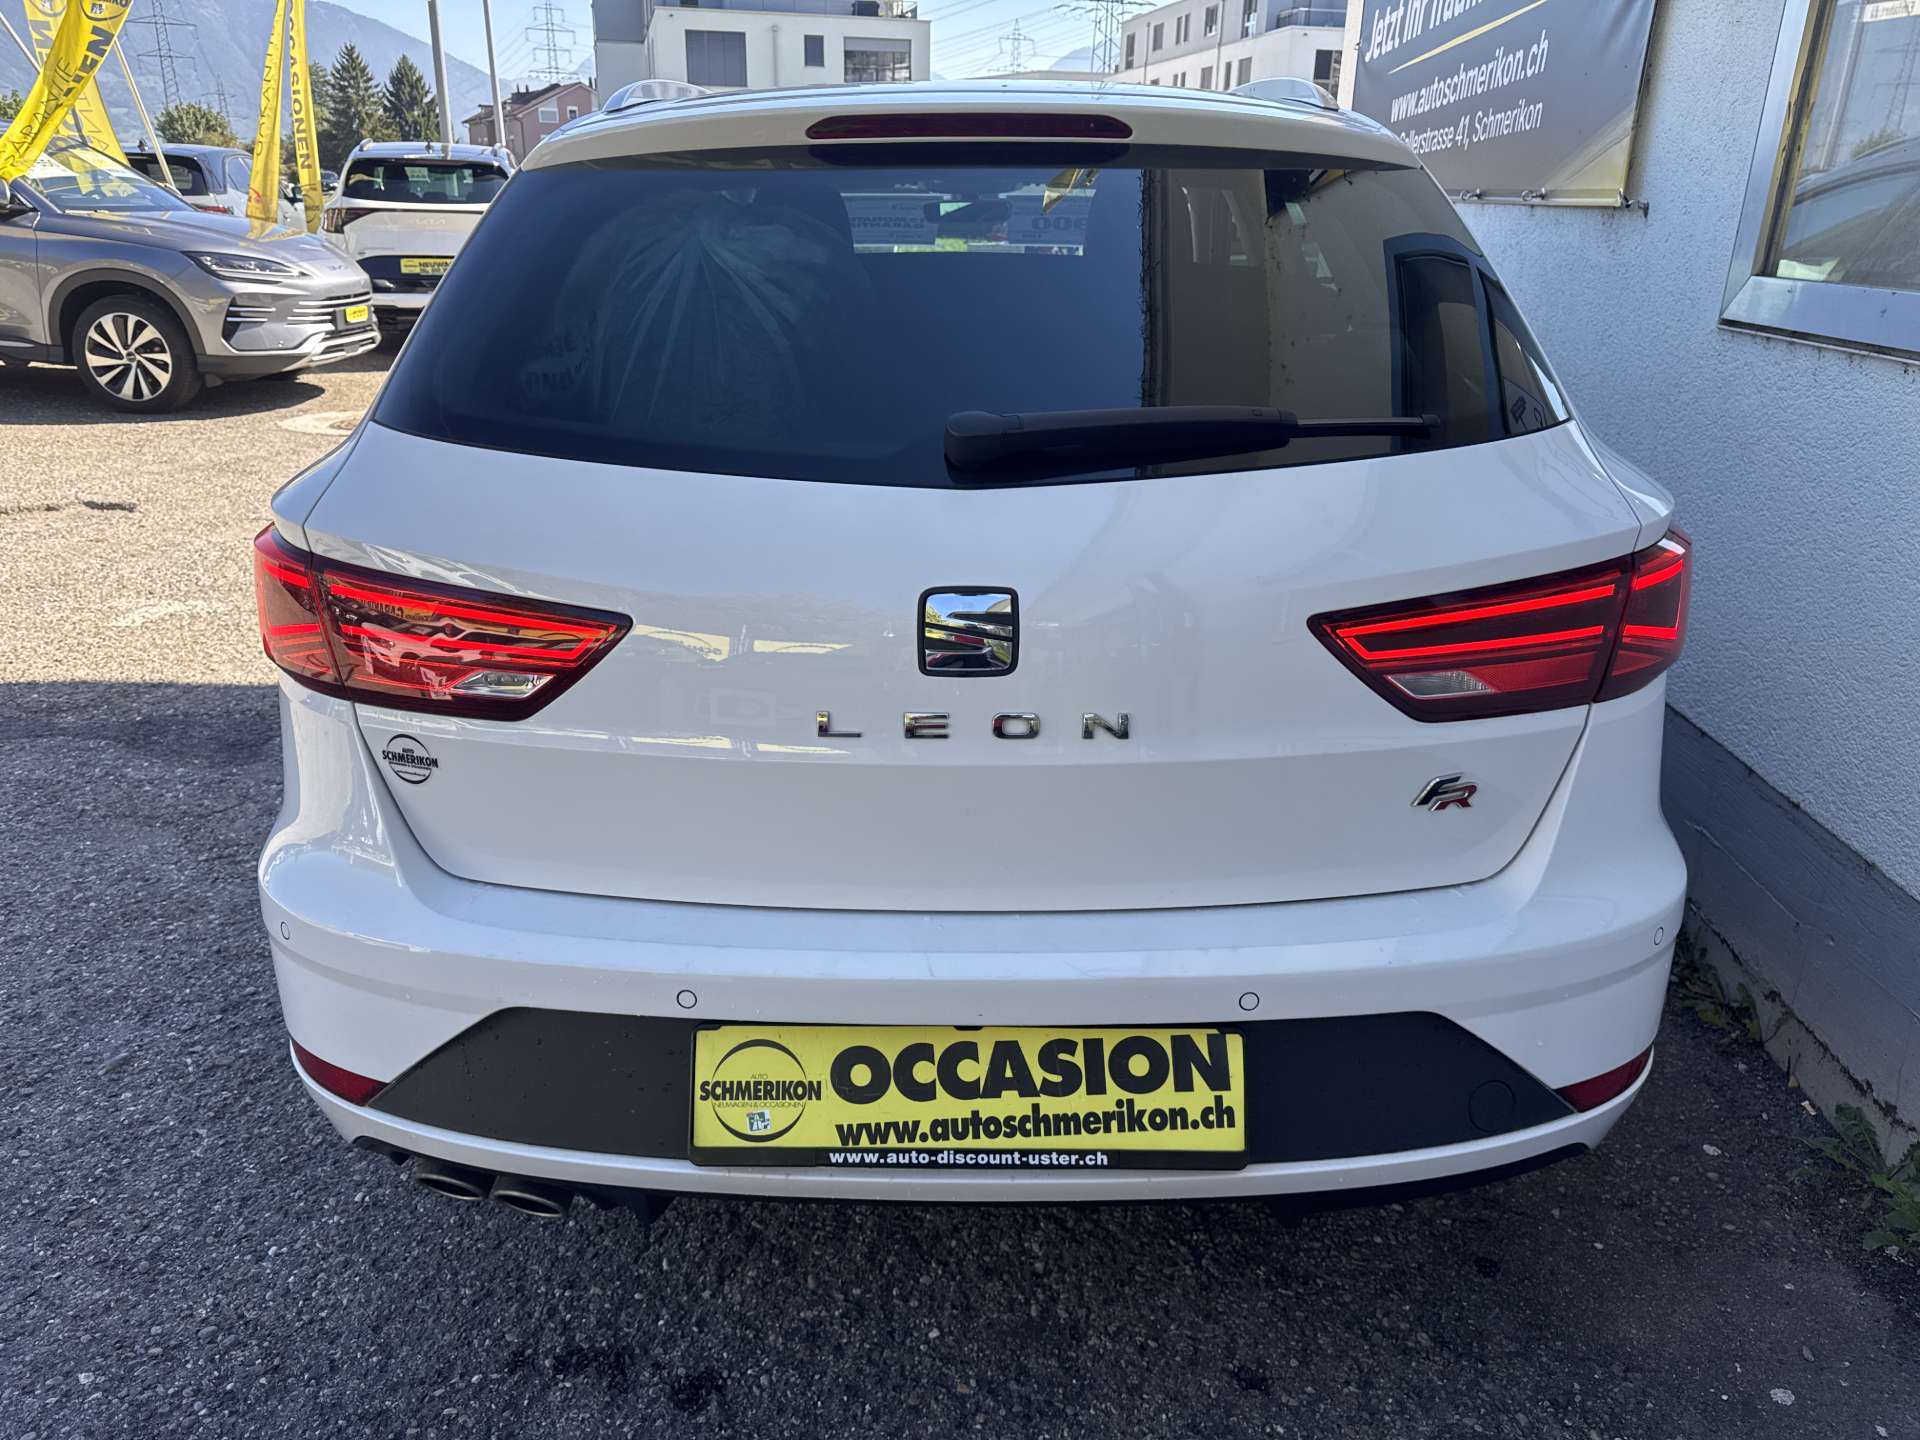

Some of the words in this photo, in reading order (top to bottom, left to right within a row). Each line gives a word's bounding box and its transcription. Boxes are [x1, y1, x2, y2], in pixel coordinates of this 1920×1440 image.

[1365, 0, 1405, 62] Jetzt
[1391, 29, 1549, 123] www.autoschmerikon.ch
[1455, 114, 1470, 151] 41,
[1473, 98, 1543, 143] Schmerikon
[816, 711, 1130, 739] LEON
[382, 749, 439, 769] SCHMERIKON
[699, 1080, 822, 1101] SCHMERIKON
[829, 1033, 1233, 1105] OCCASION
[835, 1095, 1236, 1146] www.autoschmerikon.ch
[828, 1151, 1109, 1166] www.auto-discount-uster.ch
